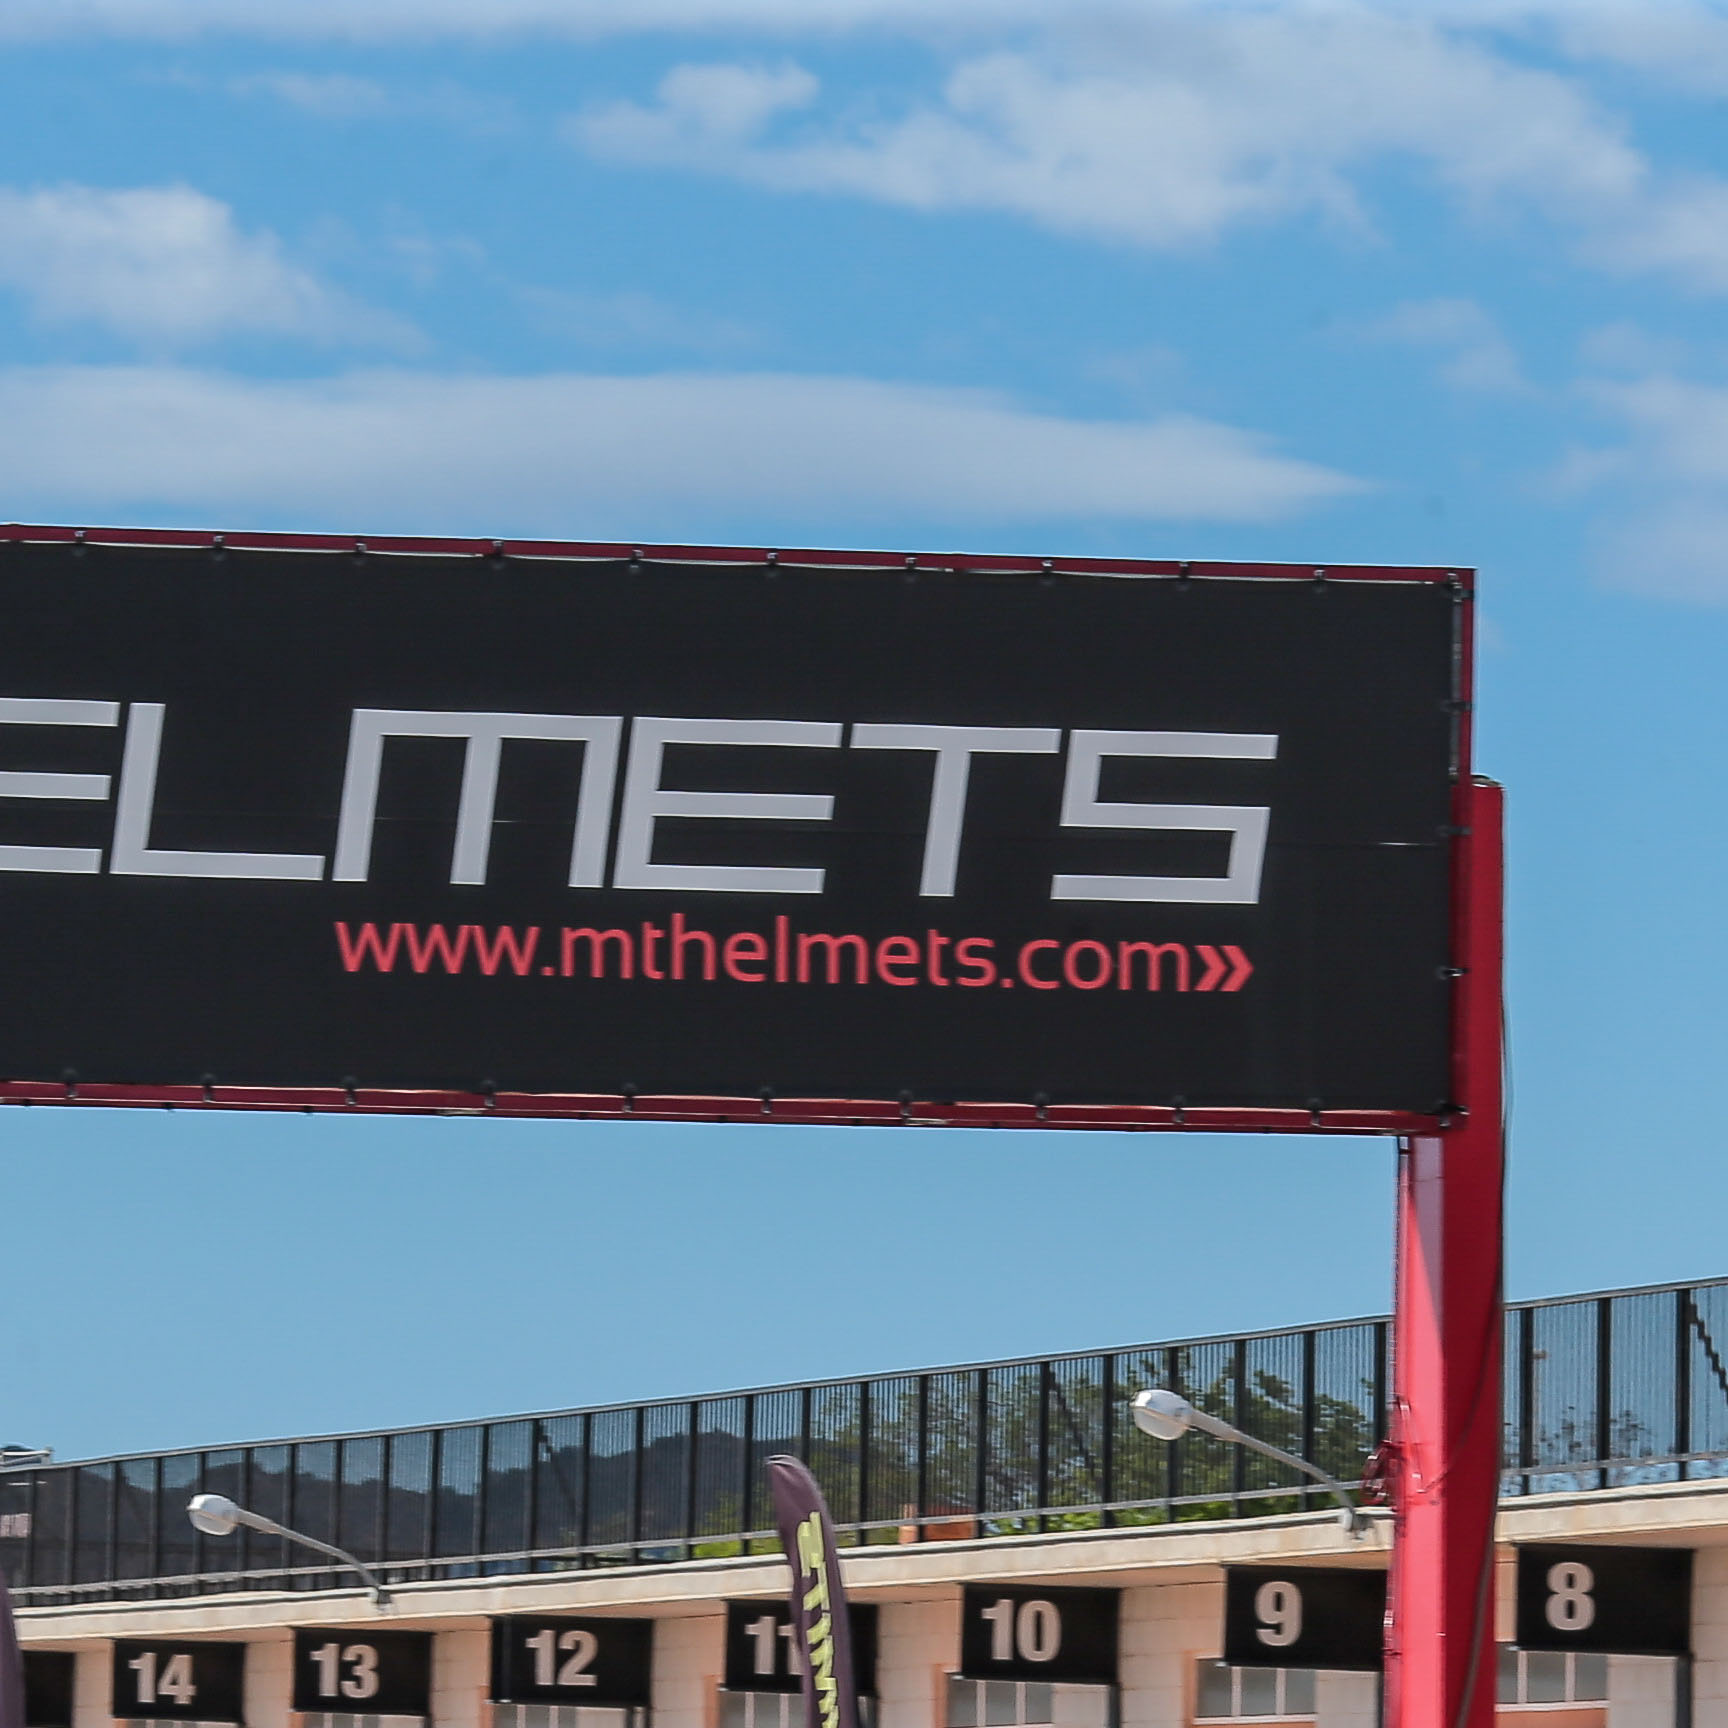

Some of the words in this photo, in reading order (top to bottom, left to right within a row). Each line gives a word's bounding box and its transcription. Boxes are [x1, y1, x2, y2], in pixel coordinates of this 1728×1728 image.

[1256, 1581, 1301, 1647] 9
[1546, 1561, 1595, 1631] 8
[525, 1629, 598, 1686] 12
[745, 1615, 803, 1676] 11
[981, 1598, 1061, 1662] 10
[128, 1652, 197, 1705] 14
[310, 1643, 379, 1699] 13
